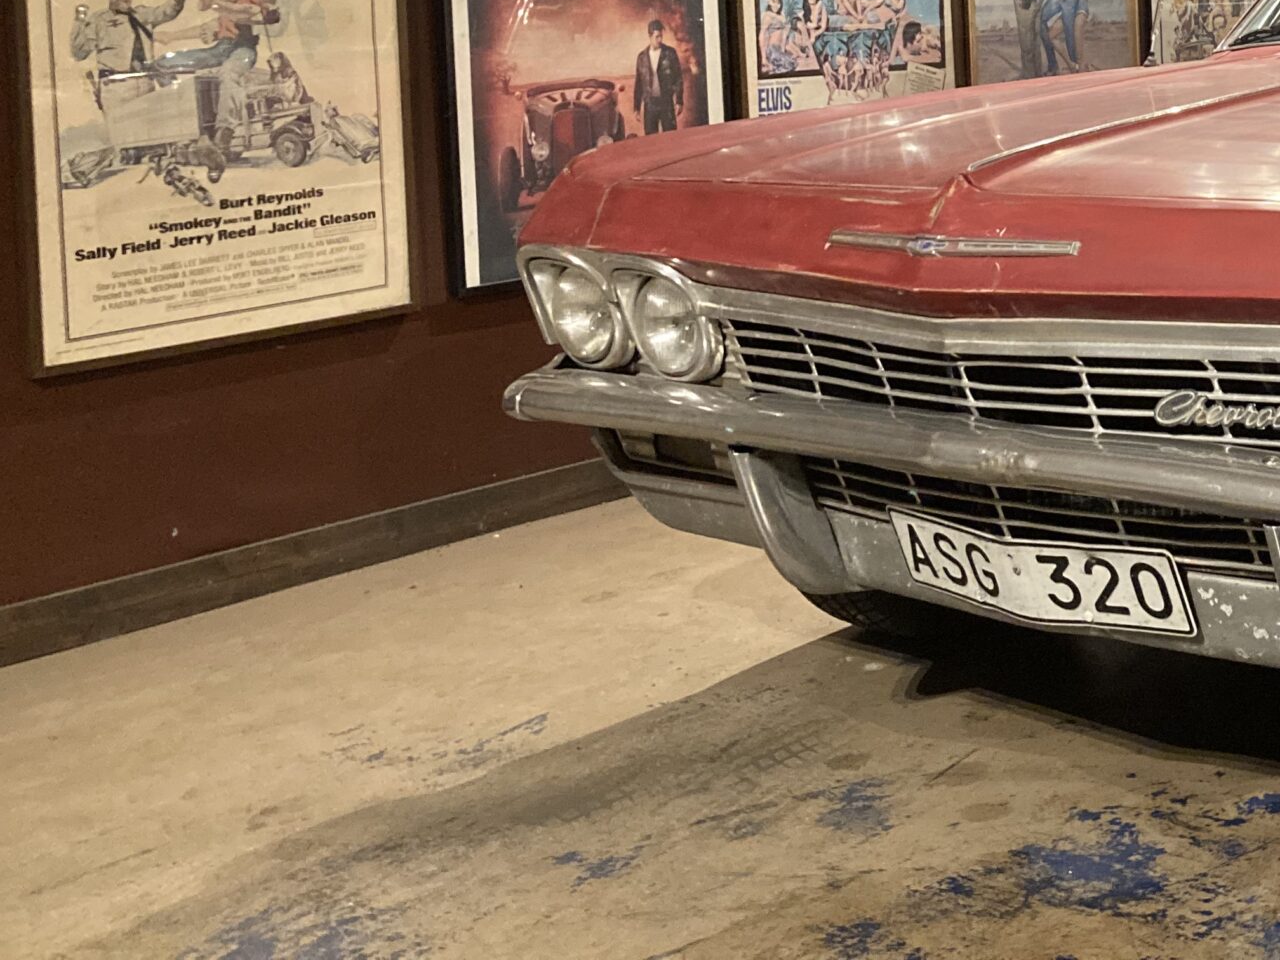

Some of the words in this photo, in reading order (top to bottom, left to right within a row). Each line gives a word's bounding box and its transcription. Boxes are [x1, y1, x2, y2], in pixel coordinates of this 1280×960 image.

[758, 86, 792, 113] ELVIS
[219, 196, 253, 210] Burt
[256, 187, 324, 207] Reynolds
[75, 245, 117, 262] Sally
[121, 239, 161, 255] Field
[169, 233, 214, 249] Jerry
[217, 226, 256, 242] Reed
[268, 218, 317, 235] Jackie
[320, 209, 376, 226] Gleason
[906, 523, 1000, 599] ASG
[1035, 554, 1174, 620] 320
